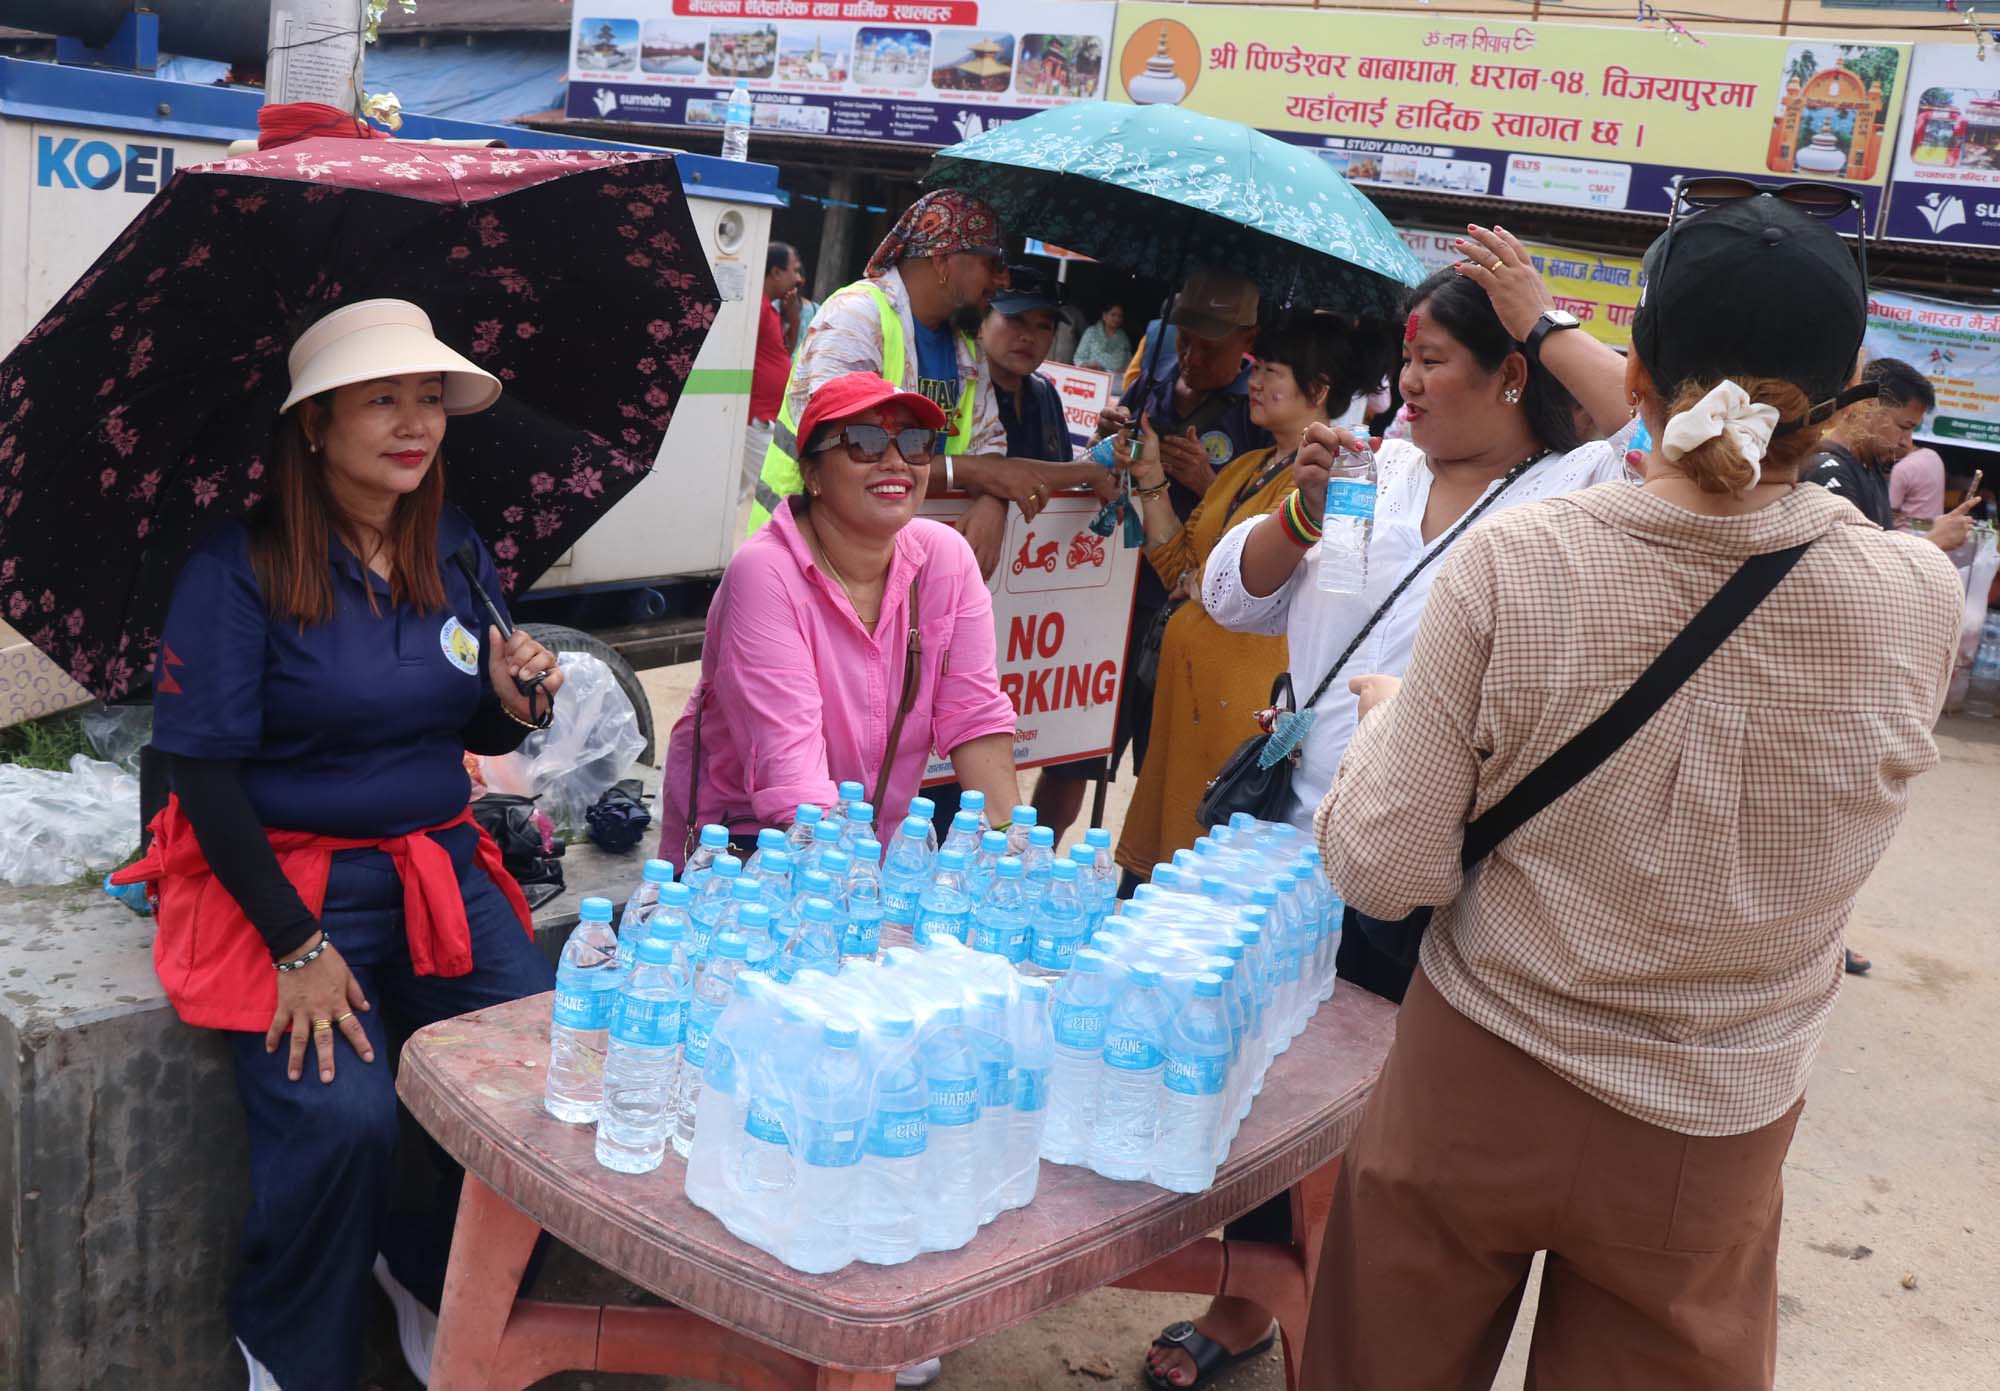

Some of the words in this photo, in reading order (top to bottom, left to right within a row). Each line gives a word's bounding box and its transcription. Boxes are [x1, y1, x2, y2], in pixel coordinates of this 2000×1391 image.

[1209, 41, 1238, 70] श्री
[1245, 42, 1352, 79] पिण्डेश्वर
[1601, 65, 1758, 112] विजयपुरमा
[619, 93, 672, 108] sumedha
[1395, 98, 1484, 133] हार्दिक
[1492, 112, 1583, 142] स्वागत
[1590, 120, 1624, 146] छ
[1347, 139, 1384, 150] STUDY
[1384, 143, 1432, 156] ABROAD
[1512, 159, 1541, 171] IELTS
[1918, 310, 1963, 328] भारत
[1006, 611, 1065, 662] NO
[1000, 659, 1117, 717] RKING
